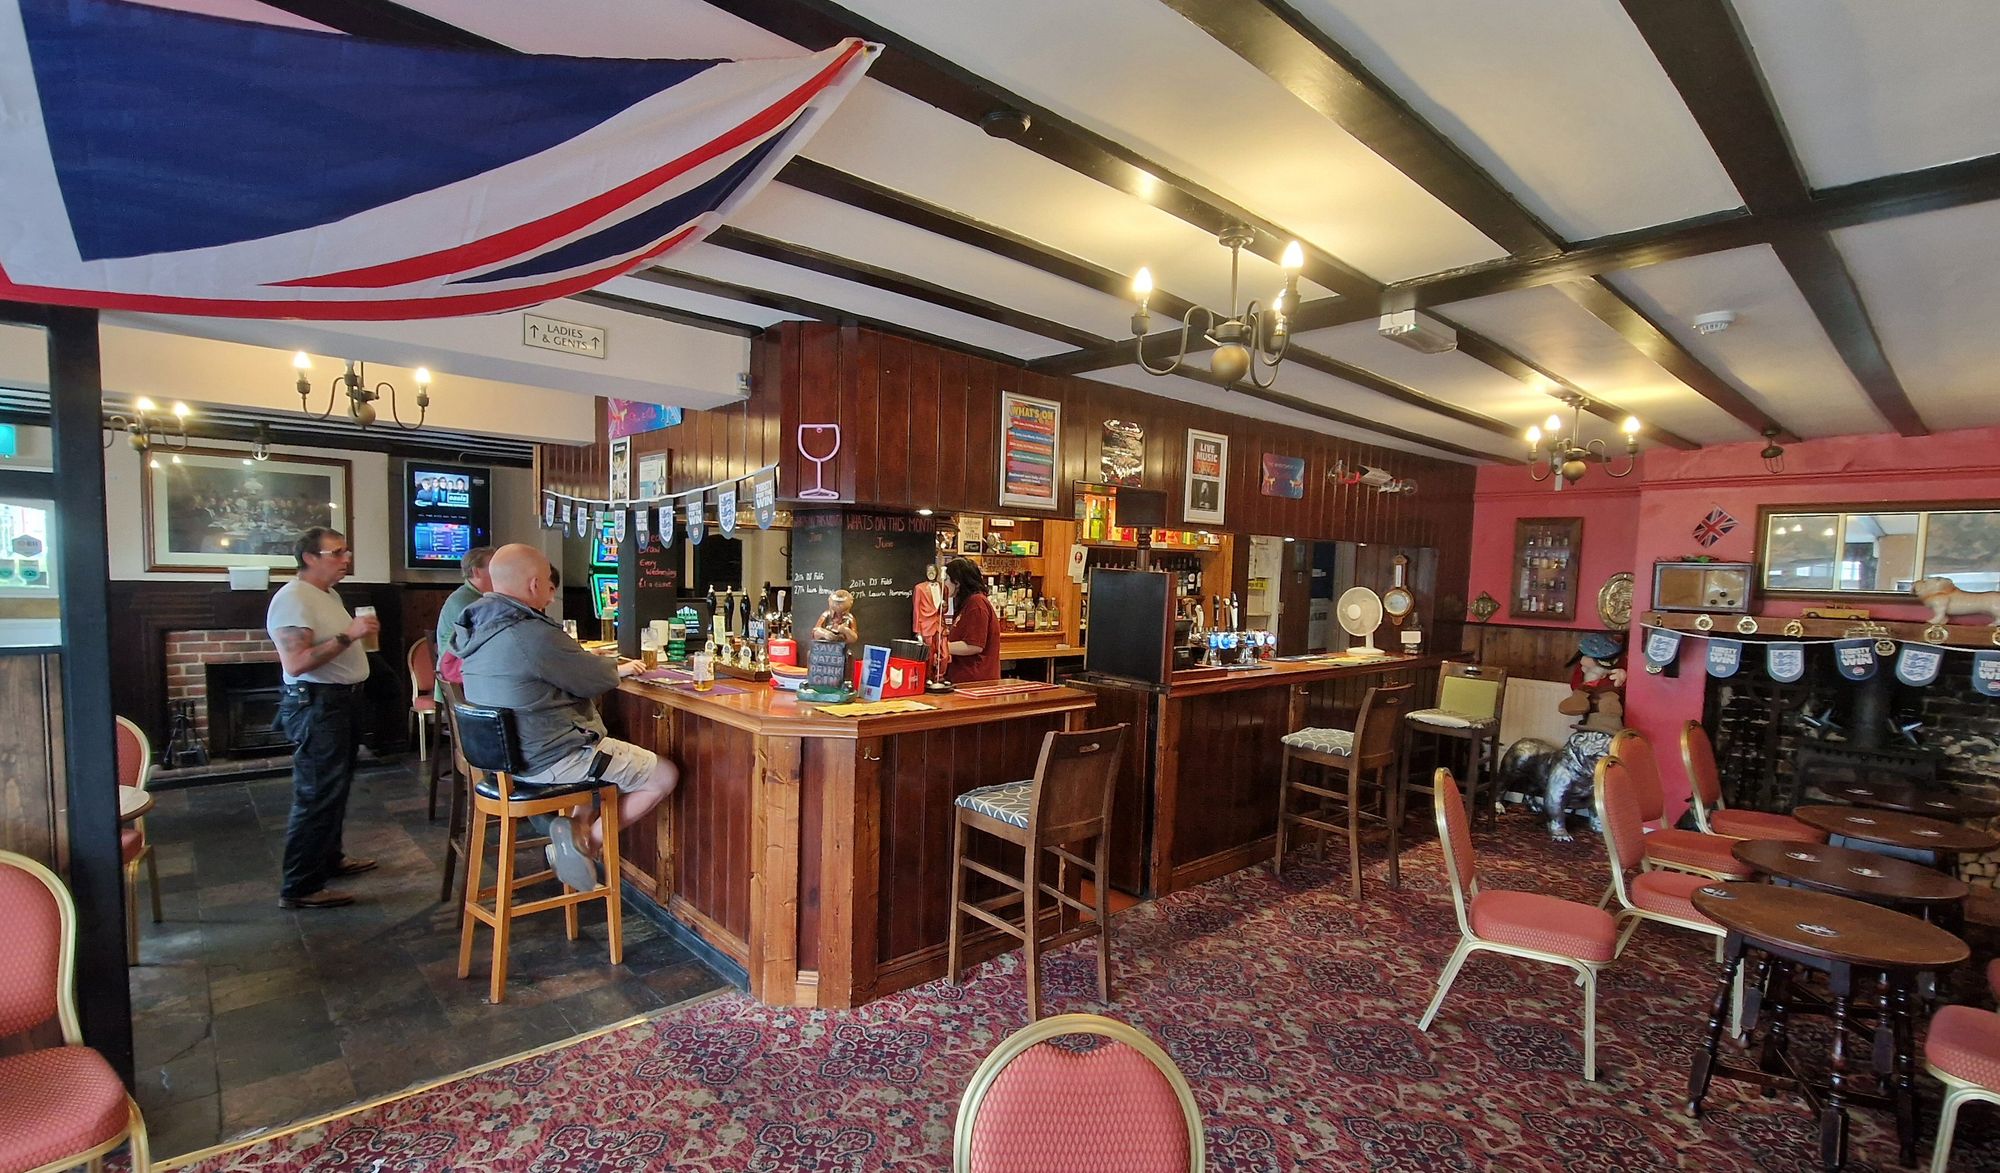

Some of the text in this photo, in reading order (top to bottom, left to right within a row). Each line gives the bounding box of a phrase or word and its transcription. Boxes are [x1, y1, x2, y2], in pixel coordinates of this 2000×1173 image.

[547, 324, 583, 339] LADIES
[542, 333, 588, 351] & GENTS
[1011, 406, 1054, 420] WHAT'S ON
[1200, 443, 1215, 454] LIVE
[1197, 451, 1218, 463] MUSIC
[756, 495, 773, 509] WIN
[875, 515, 886, 531] ON
[887, 515, 905, 533] THIS
[908, 516, 936, 534] MONTH
[813, 642, 841, 653] SAVE
[812, 653, 843, 665] WATER
[1710, 656, 1737, 665] WIN
[1842, 657, 1874, 666] WIN
[811, 664, 842, 676] DRINK
[813, 675, 838, 687] GIN
